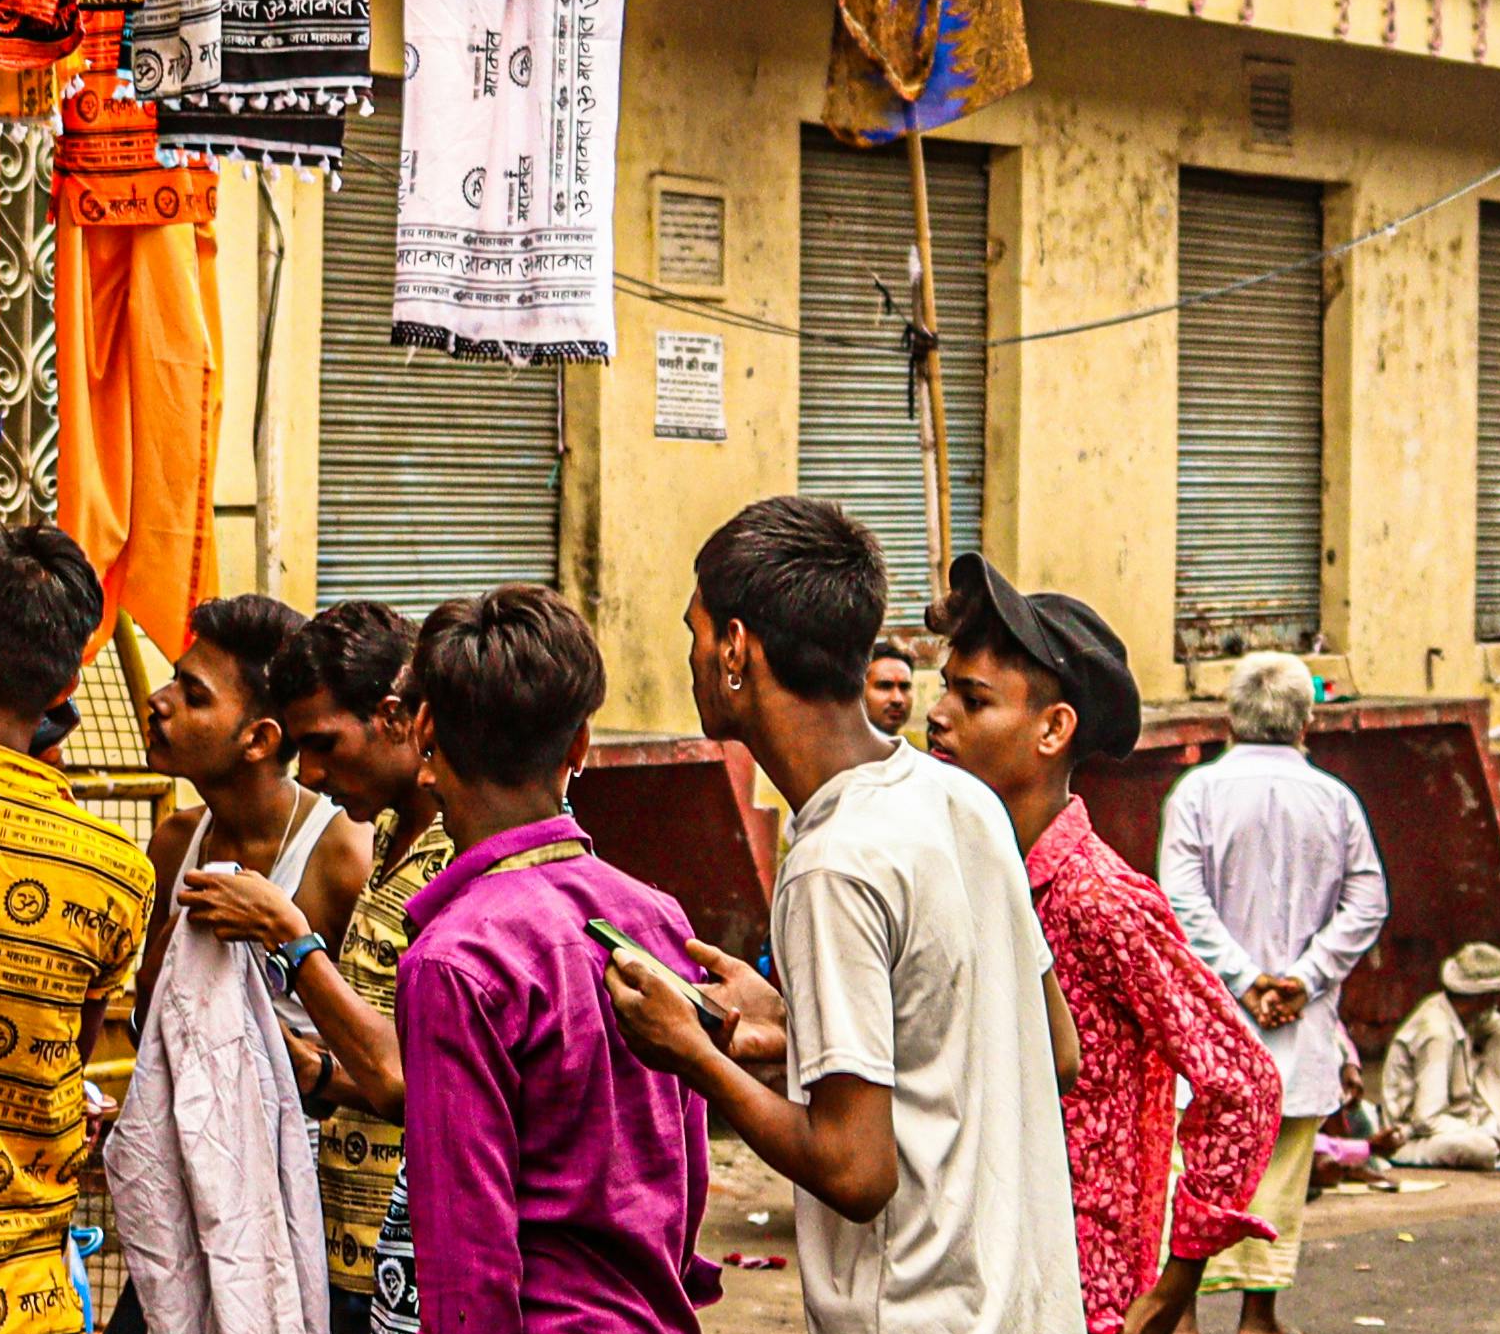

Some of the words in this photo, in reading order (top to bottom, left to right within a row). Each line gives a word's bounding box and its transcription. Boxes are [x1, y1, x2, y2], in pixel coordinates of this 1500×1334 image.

[577, 16, 595, 82] महाकाल
[577, 86, 597, 114] ॐ
[576, 120, 592, 188] महाकाल
